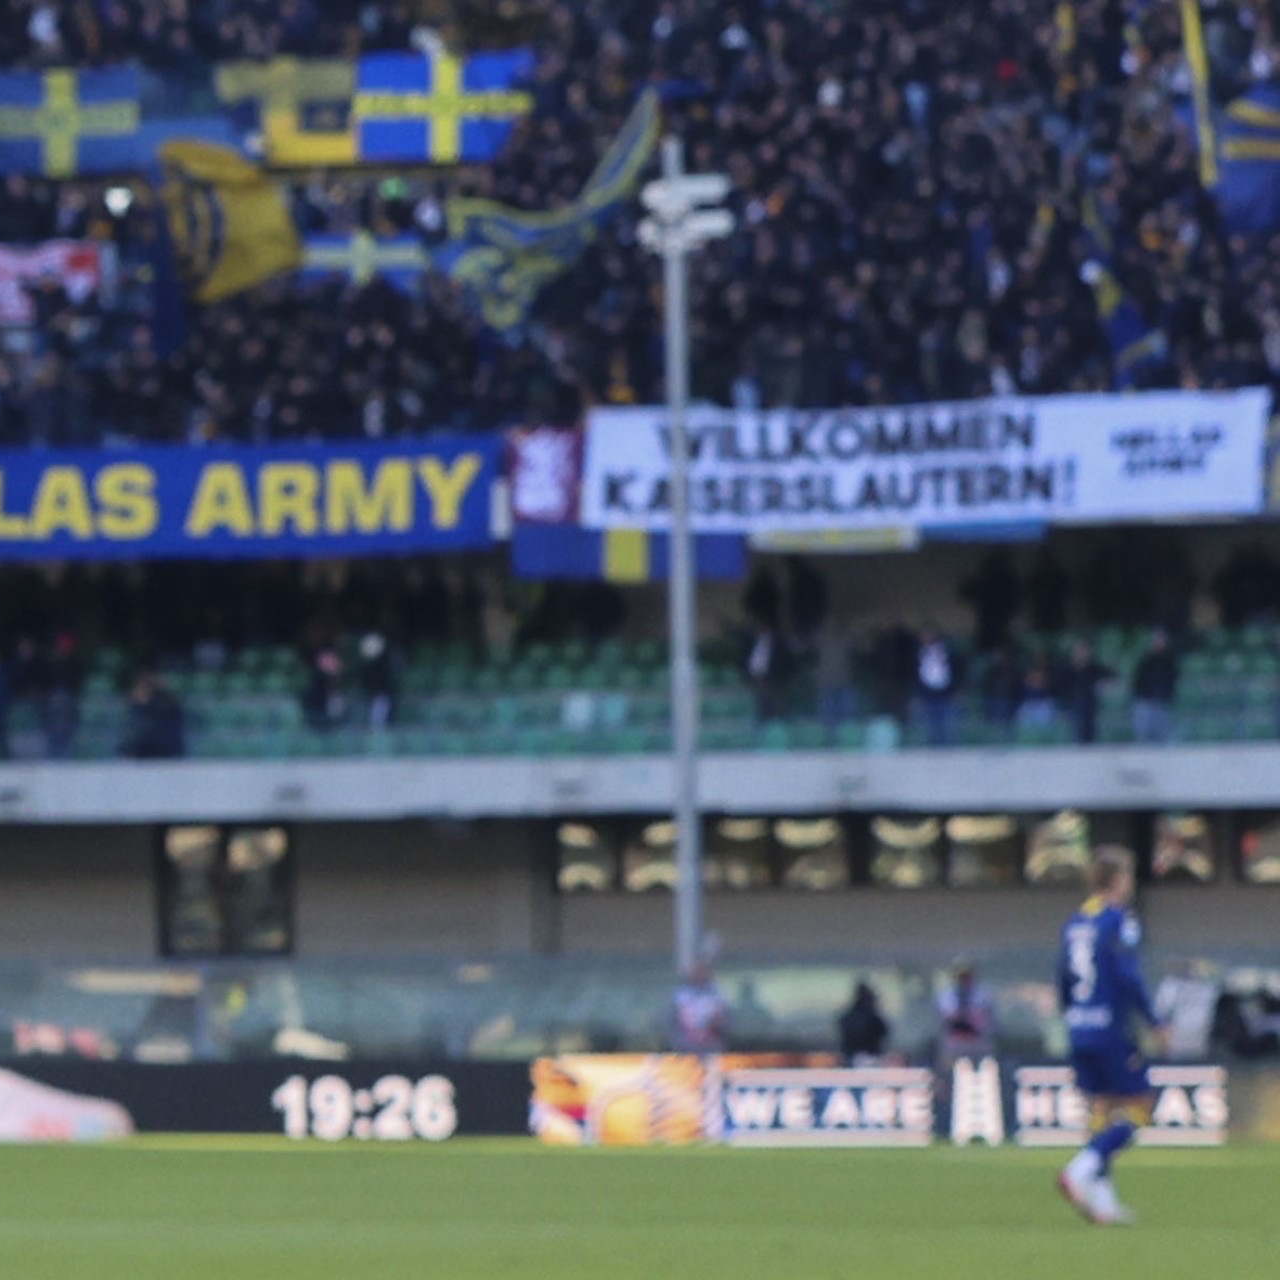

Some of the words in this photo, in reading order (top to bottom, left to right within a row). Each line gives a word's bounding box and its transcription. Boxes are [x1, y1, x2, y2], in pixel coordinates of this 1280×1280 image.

[186, 453, 482, 538] ARMY
[271, 1074, 457, 1141] 19:26
[726, 1087, 814, 1128] WE
[821, 1087, 931, 1128] ARE
[1016, 1087, 1229, 1128] HEAS
